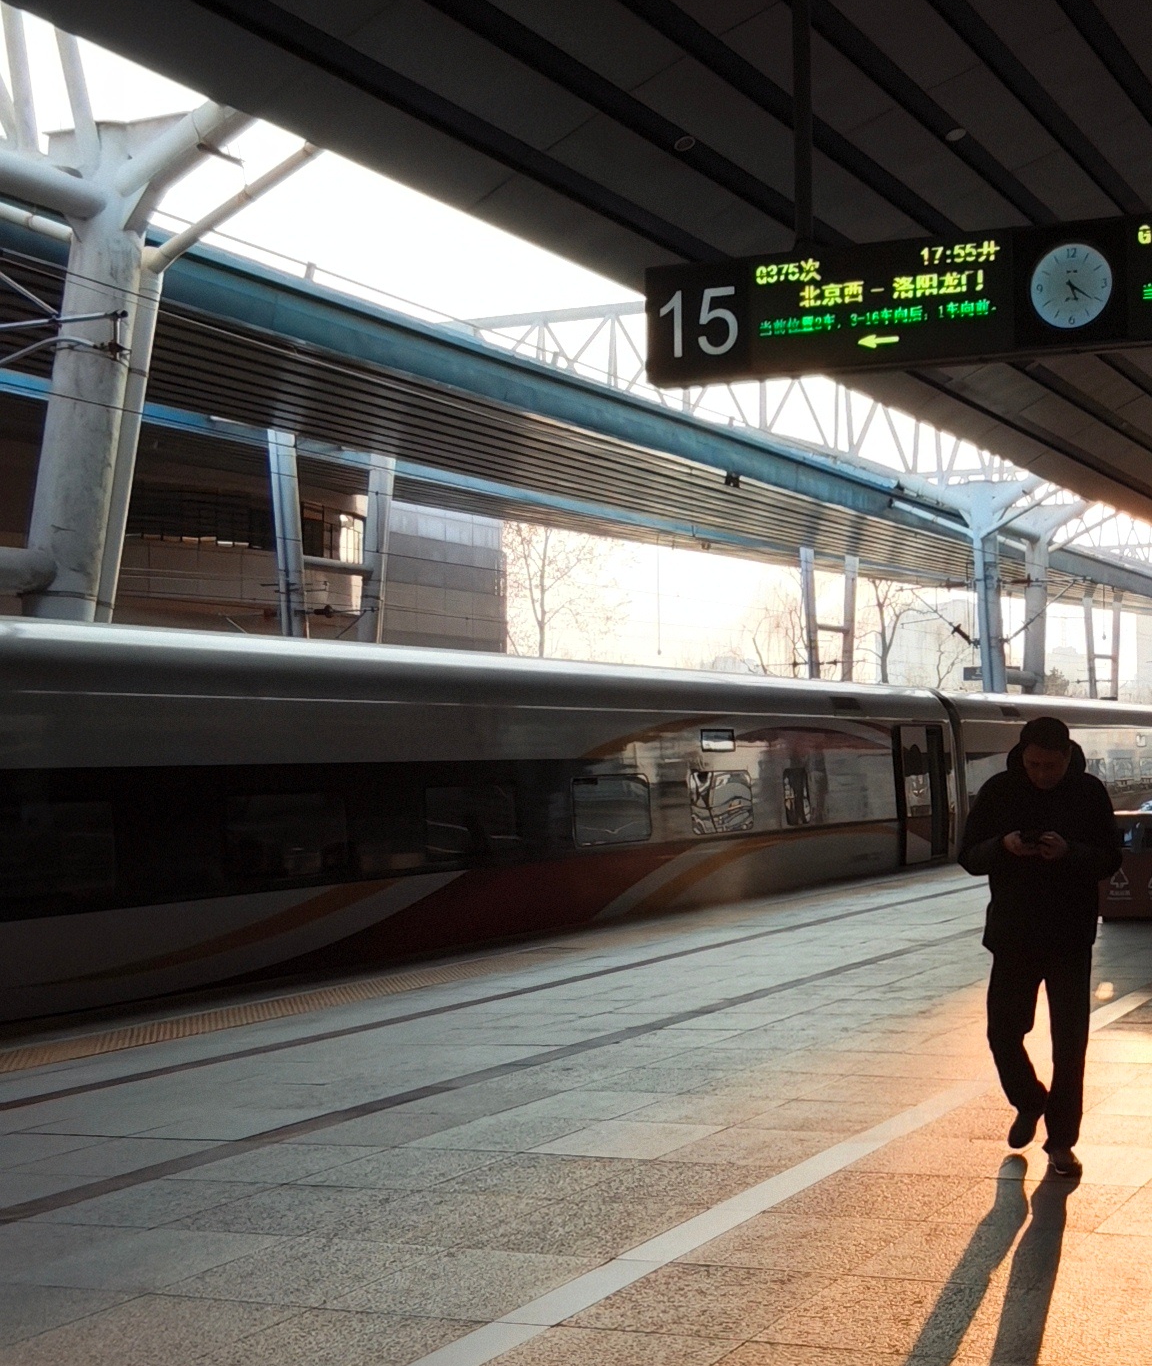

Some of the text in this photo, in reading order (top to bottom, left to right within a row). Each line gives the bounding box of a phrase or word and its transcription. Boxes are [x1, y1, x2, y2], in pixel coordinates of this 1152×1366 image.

[920, 240, 1001, 266] 17:55开
[1066, 247, 1077, 259] 12
[658, 285, 739, 359] 15
